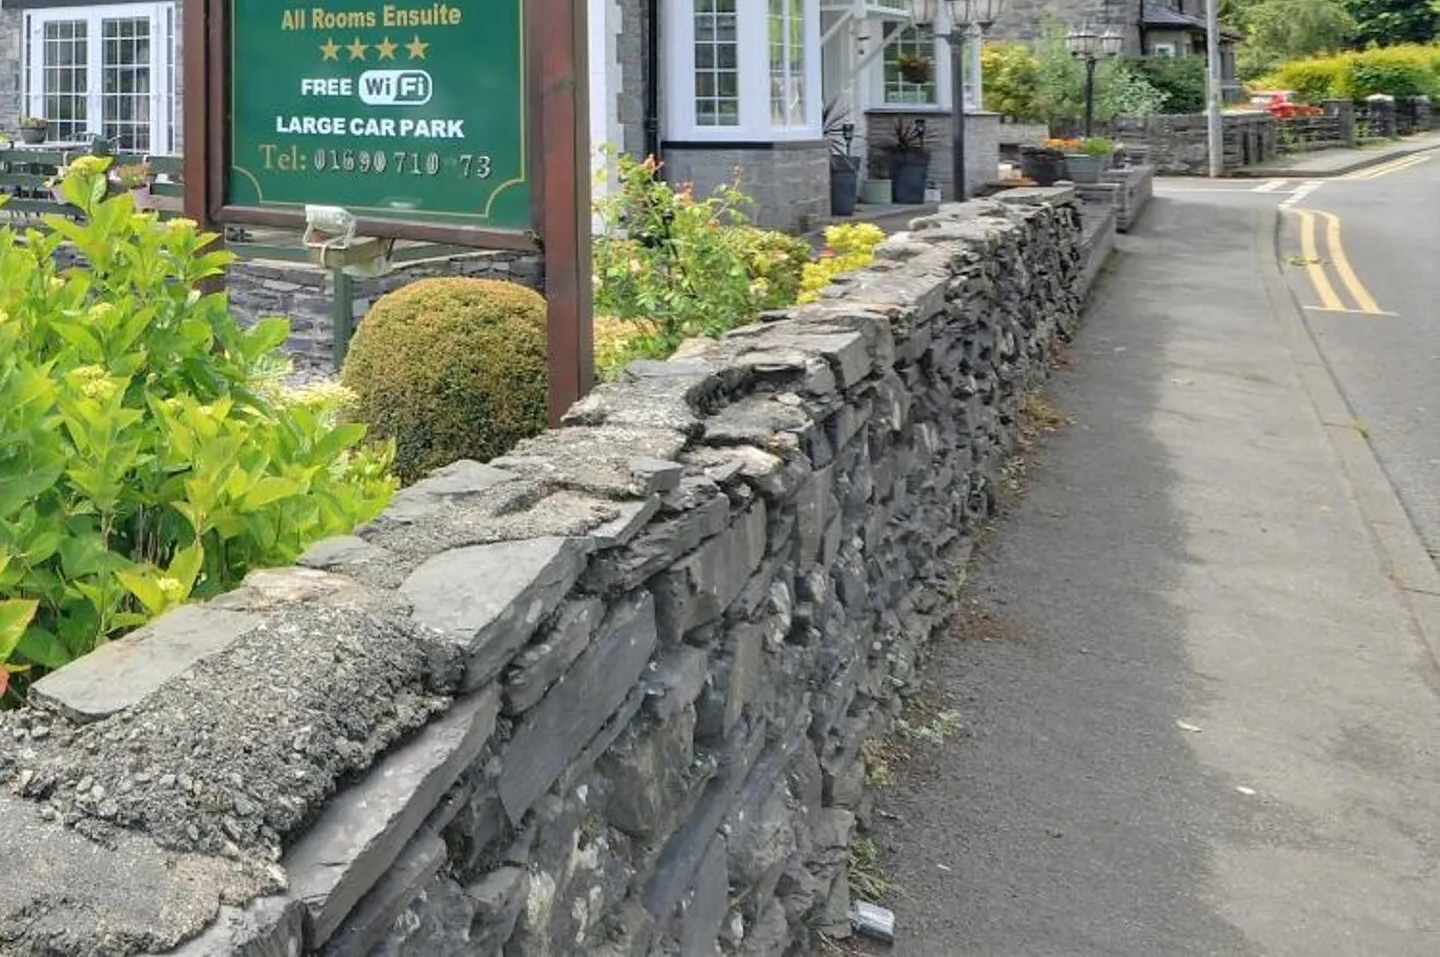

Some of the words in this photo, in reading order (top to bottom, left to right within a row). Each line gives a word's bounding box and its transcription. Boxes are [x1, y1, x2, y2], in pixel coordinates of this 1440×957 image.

[281, 9, 305, 30] All
[312, 7, 376, 29] Rooms
[383, 3, 462, 27] Ensuite
[301, 78, 352, 96] FREE
[276, 116, 347, 135] LARGE
[349, 118, 397, 137] CAR
[399, 119, 466, 139] PARK
[259, 144, 307, 171] Tel:
[314, 148, 387, 174] 01690
[394, 151, 441, 175] 710
